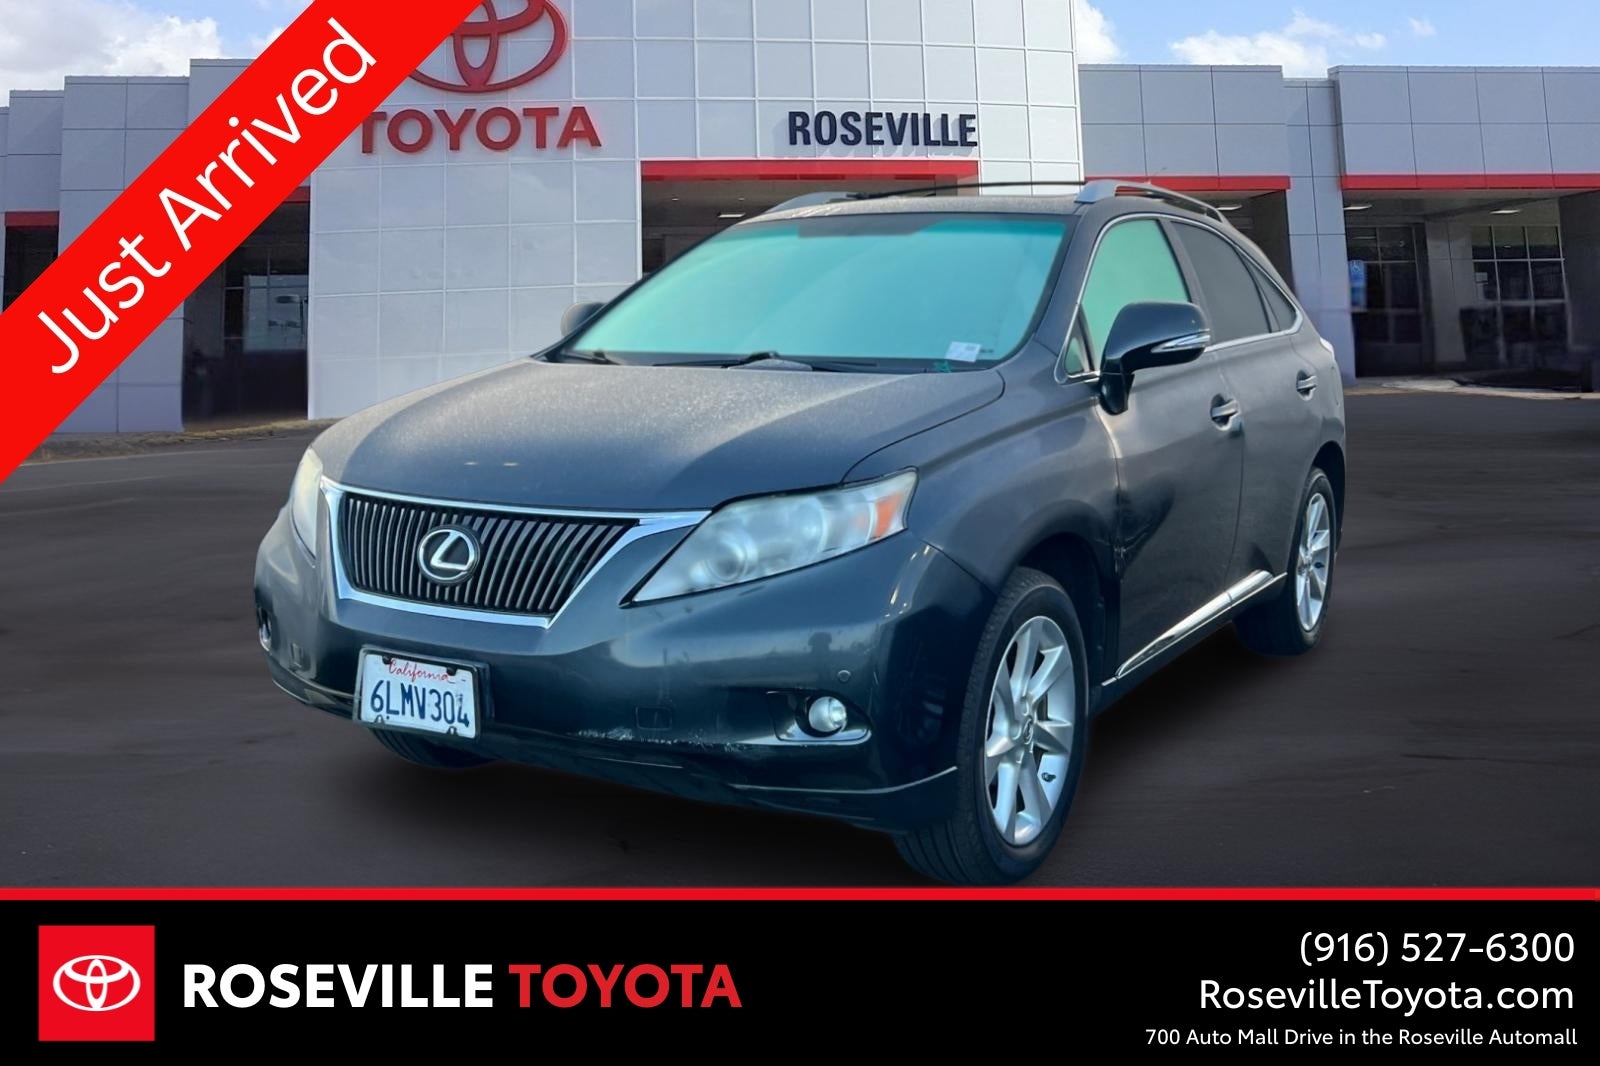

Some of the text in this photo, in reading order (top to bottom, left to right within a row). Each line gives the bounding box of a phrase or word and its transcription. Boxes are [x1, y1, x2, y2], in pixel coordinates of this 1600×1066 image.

[361, 106, 603, 155] TOYOTA
[788, 110, 978, 147] ROSEVILLE
[388, 659, 456, 684] California
[370, 679, 470, 728] 6LMV304
